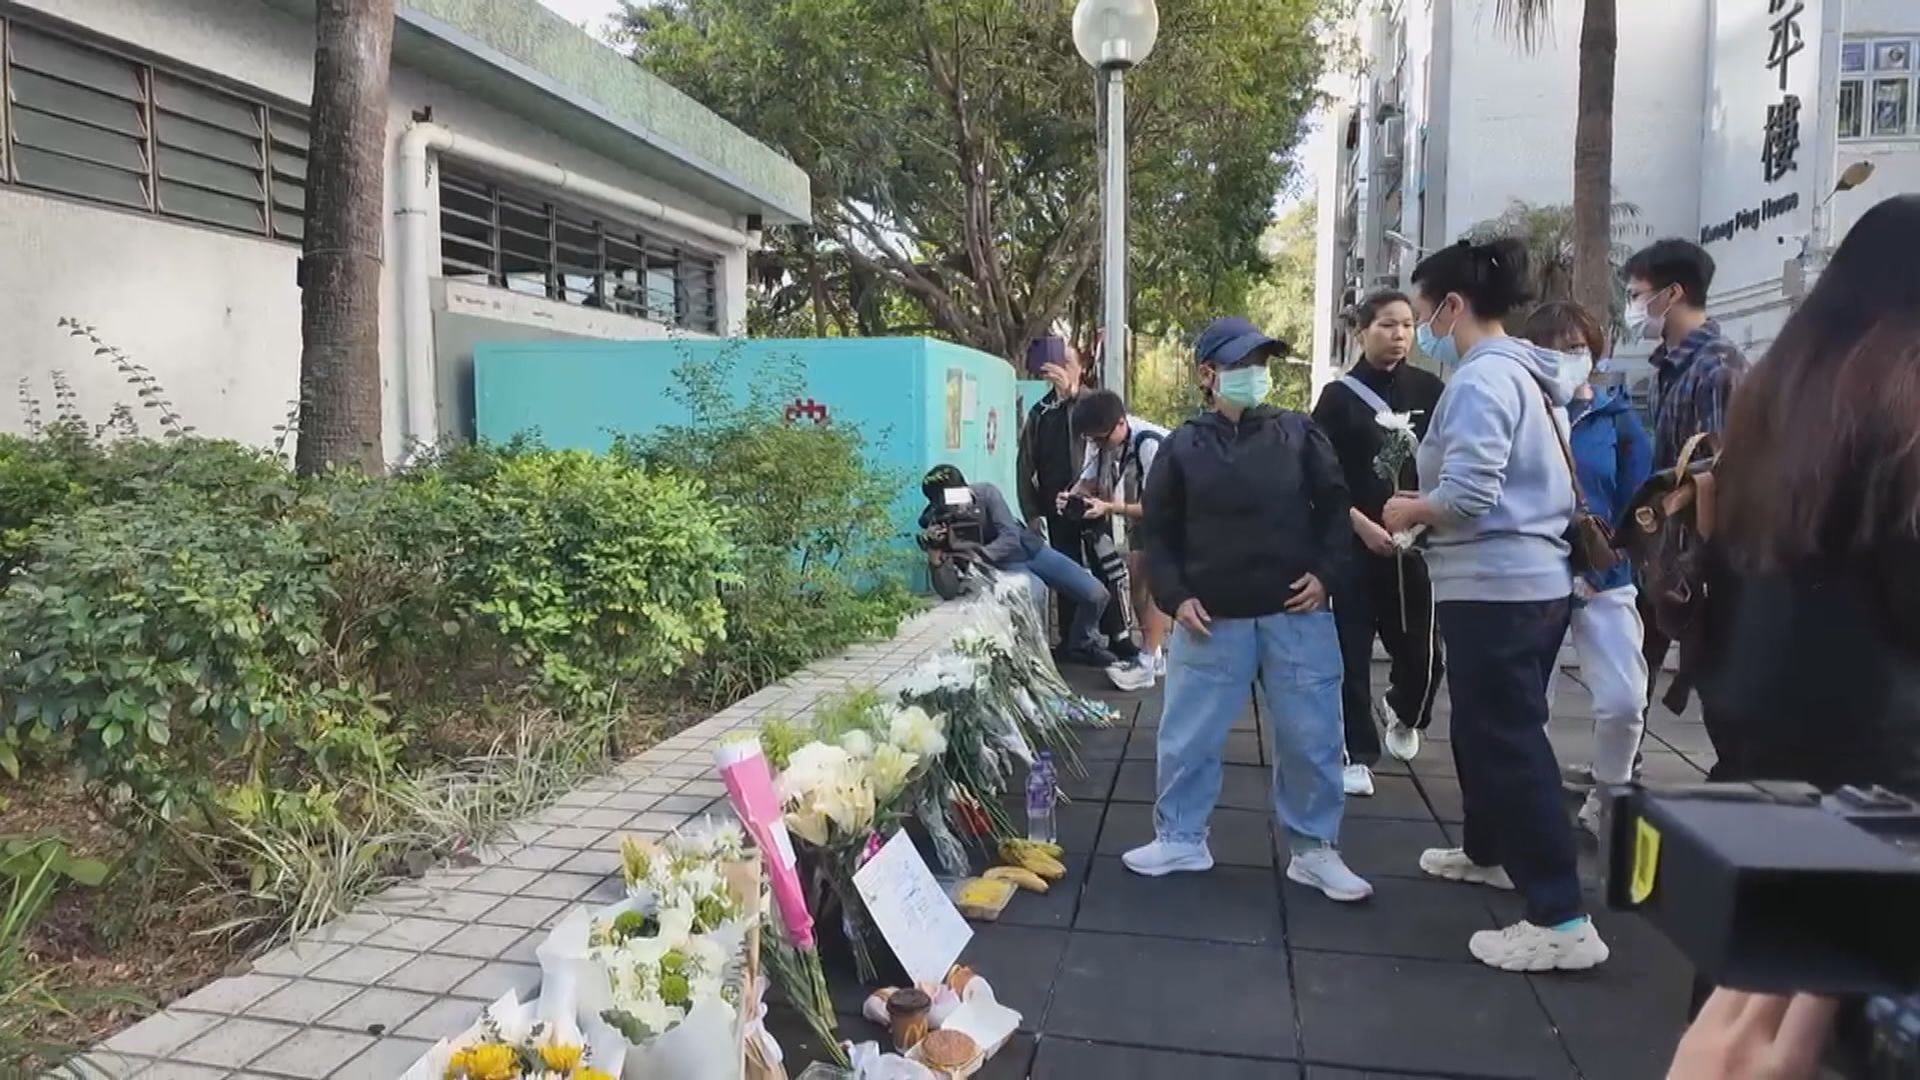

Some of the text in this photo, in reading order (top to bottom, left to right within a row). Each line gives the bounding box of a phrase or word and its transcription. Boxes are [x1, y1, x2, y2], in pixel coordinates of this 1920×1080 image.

[1762, 0, 1804, 182] 平樓
[1735, 208, 1760, 232] Ping
[1762, 192, 1799, 221] House
